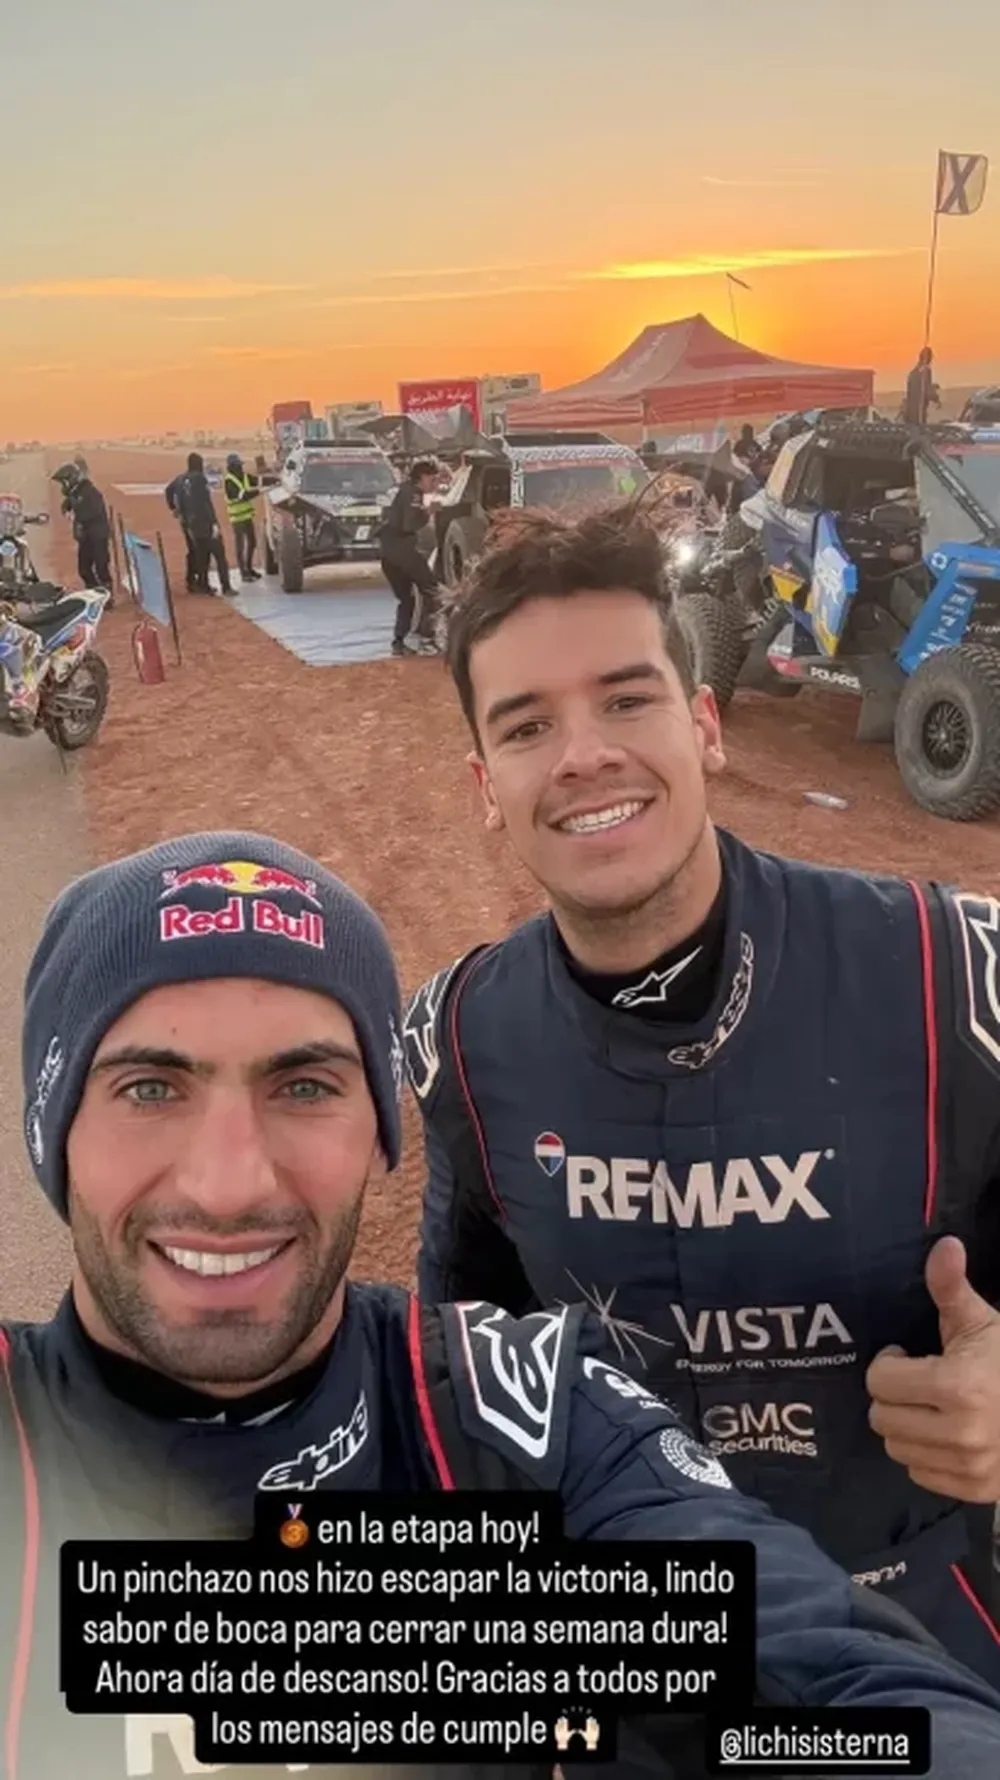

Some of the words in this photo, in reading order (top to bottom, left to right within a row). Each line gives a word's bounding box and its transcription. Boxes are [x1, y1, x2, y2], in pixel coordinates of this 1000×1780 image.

[810, 666, 862, 690] POLARIS
[160, 896, 245, 941] Red
[252, 899, 324, 949] Bull
[669, 1302, 854, 1353] VISTA
[736, 1358, 765, 1371] FOR
[767, 1351, 857, 1369] TOMORROW
[702, 1402, 816, 1439] GMC
